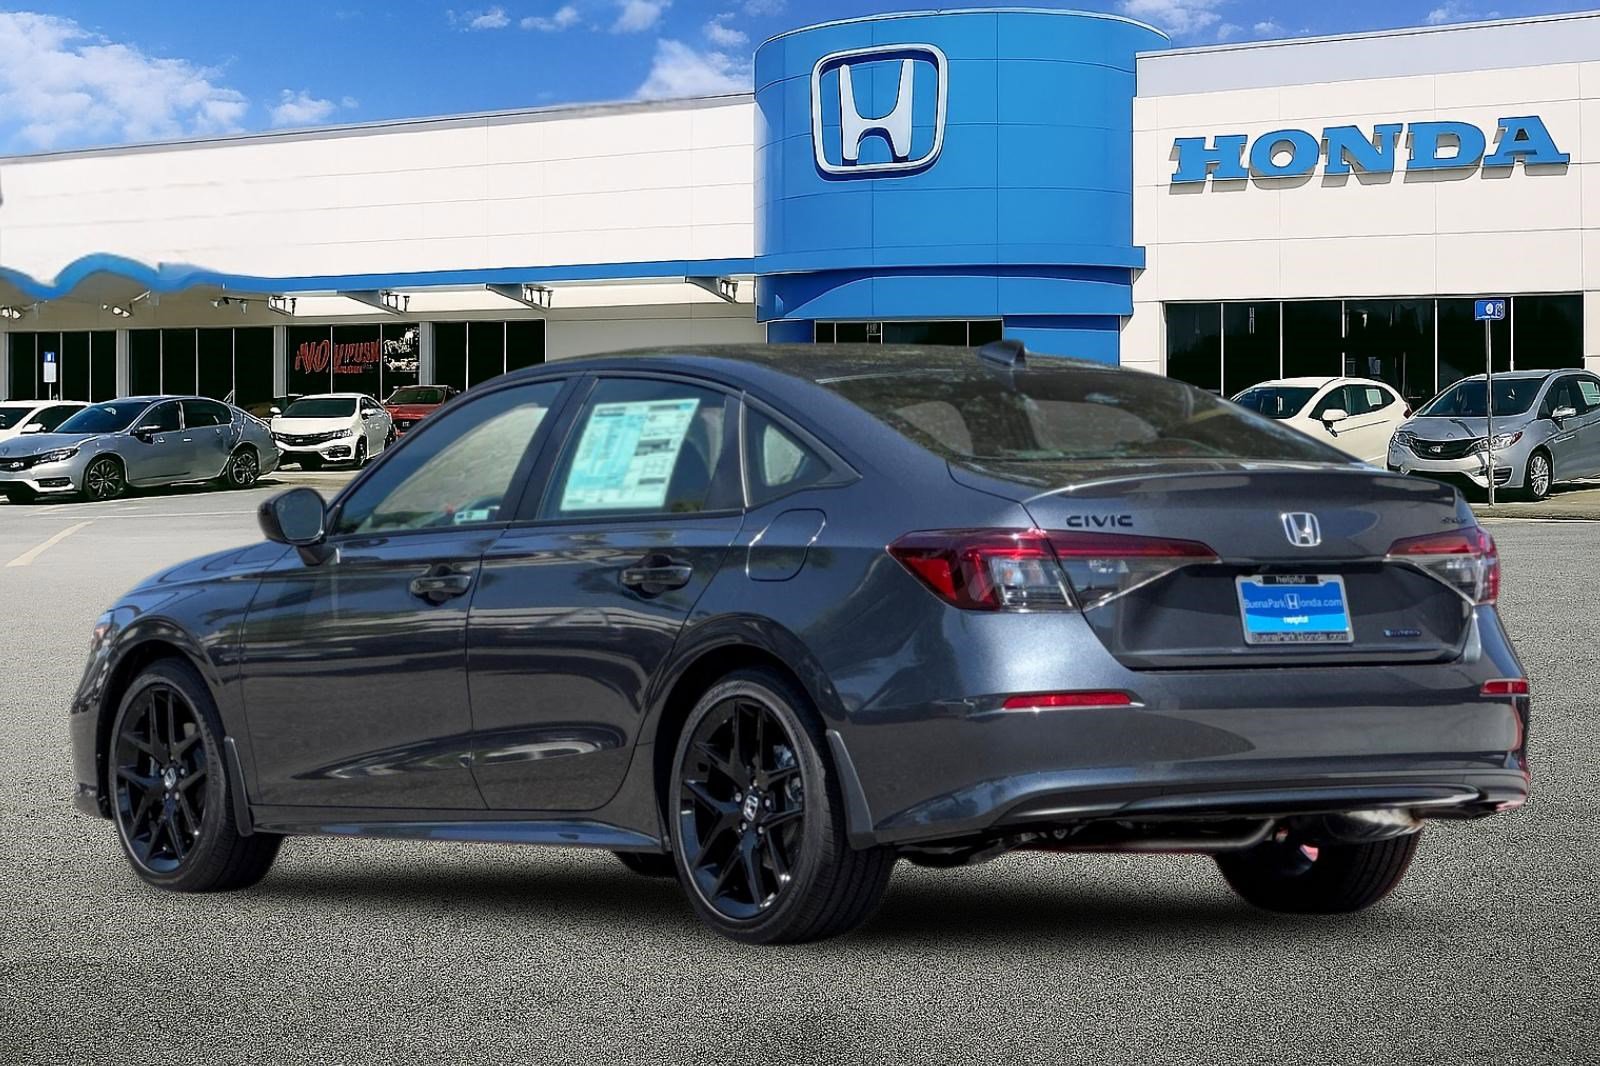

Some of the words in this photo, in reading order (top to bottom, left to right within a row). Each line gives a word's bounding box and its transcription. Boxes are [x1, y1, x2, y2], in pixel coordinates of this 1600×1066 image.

[1171, 115, 1571, 184] HONDA
[1066, 514, 1134, 527] CIVIC
[1275, 575, 1307, 585] helpful
